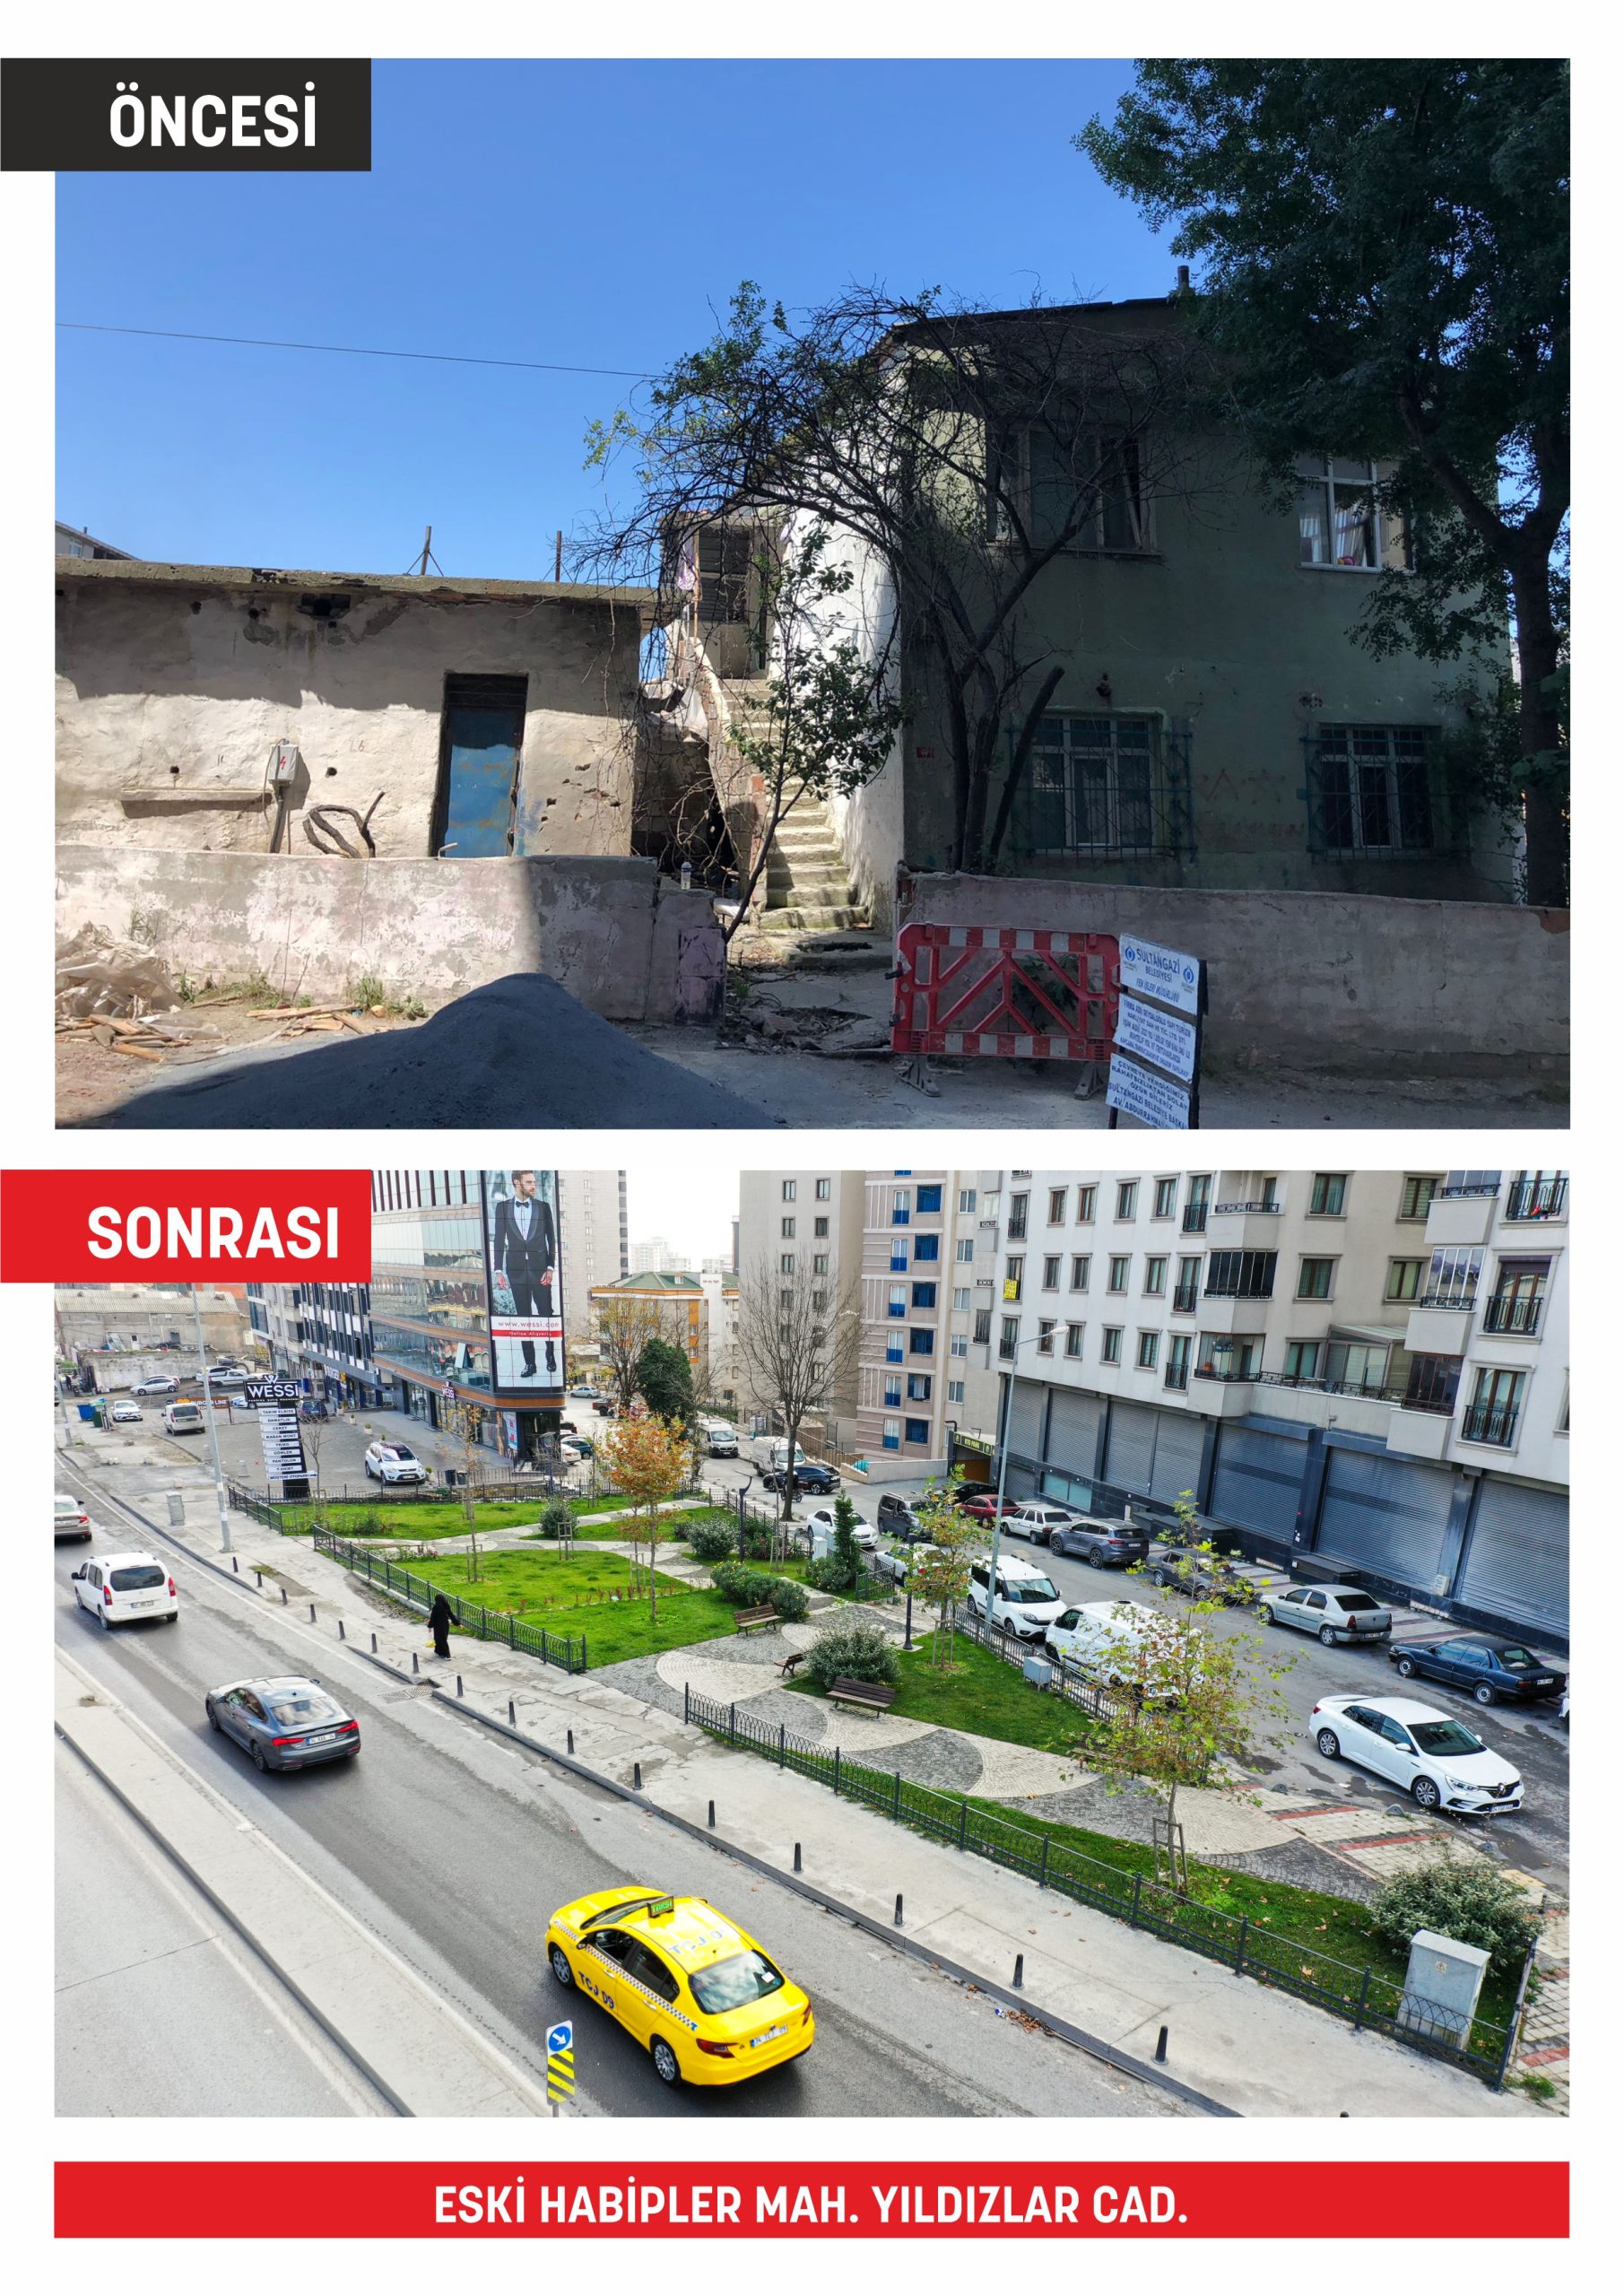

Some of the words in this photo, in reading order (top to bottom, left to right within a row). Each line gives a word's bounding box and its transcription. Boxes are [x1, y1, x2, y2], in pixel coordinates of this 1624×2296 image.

[1136, 948, 1180, 975] SULTANGAZİ
[1145, 965, 1173, 983] BELEDİYESİ
[248, 1384, 299, 1398] WESSI
[578, 1970, 599, 1996] TCJ
